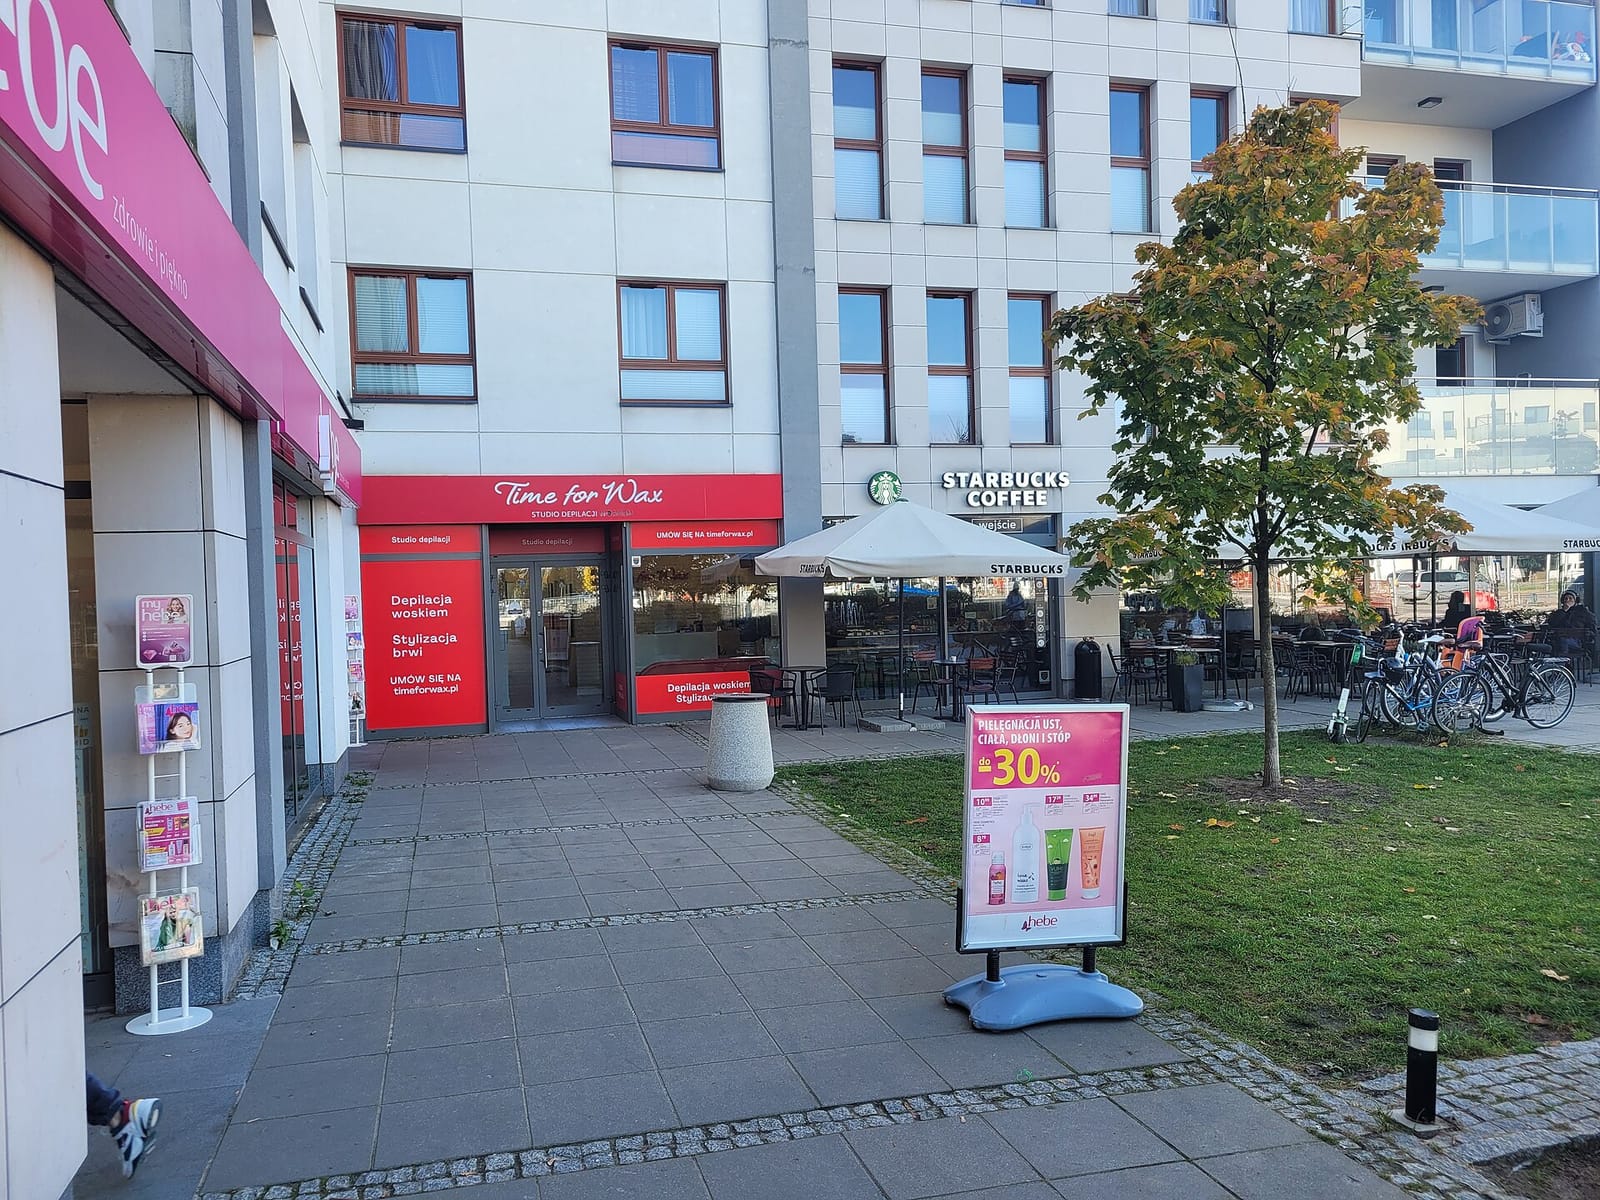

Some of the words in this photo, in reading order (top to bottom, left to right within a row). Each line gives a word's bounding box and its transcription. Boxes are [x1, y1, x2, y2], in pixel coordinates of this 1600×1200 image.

[113, 195, 154, 262] zdrowie
[155, 240, 159, 267] i
[160, 251, 188, 299] piękno
[942, 471, 1070, 488] STARBUCKS
[494, 481, 558, 505] Time
[562, 484, 598, 506] for
[602, 478, 663, 505] Wax
[967, 490, 1048, 507] COFFEE
[561, 510, 598, 518] DEPILACJI
[978, 519, 1017, 532] wejście
[391, 536, 417, 544] Studio
[418, 535, 451, 545] depilacji
[656, 531, 681, 539] UMÓW
[682, 531, 694, 540] SIĘ
[706, 530, 754, 538] timeforwax.pl
[545, 538, 573, 546] depilacji
[799, 564, 825, 573] STARBUCKS
[990, 564, 1063, 574] STARBUCKS
[141, 600, 160, 611] my
[391, 595, 453, 607] Depilacja
[141, 608, 180, 622] hebe
[391, 608, 448, 619] woskiem
[392, 632, 458, 646] Stylizacja
[392, 647, 423, 658] brwi
[390, 674, 426, 685] UMÓW
[428, 673, 445, 684] SIĘ
[447, 673, 462, 682] NA
[393, 684, 459, 696] timeforwax.pl
[667, 682, 711, 693] Depilacja
[978, 719, 1041, 732] PIELĘGNACJA
[1042, 719, 1063, 730] UST,
[1010, 733, 1039, 744] DŁONI
[1041, 733, 1045, 743] I
[1047, 731, 1071, 743] STÓP
[978, 757, 991, 766] do
[1027, 915, 1058, 928] hebe
